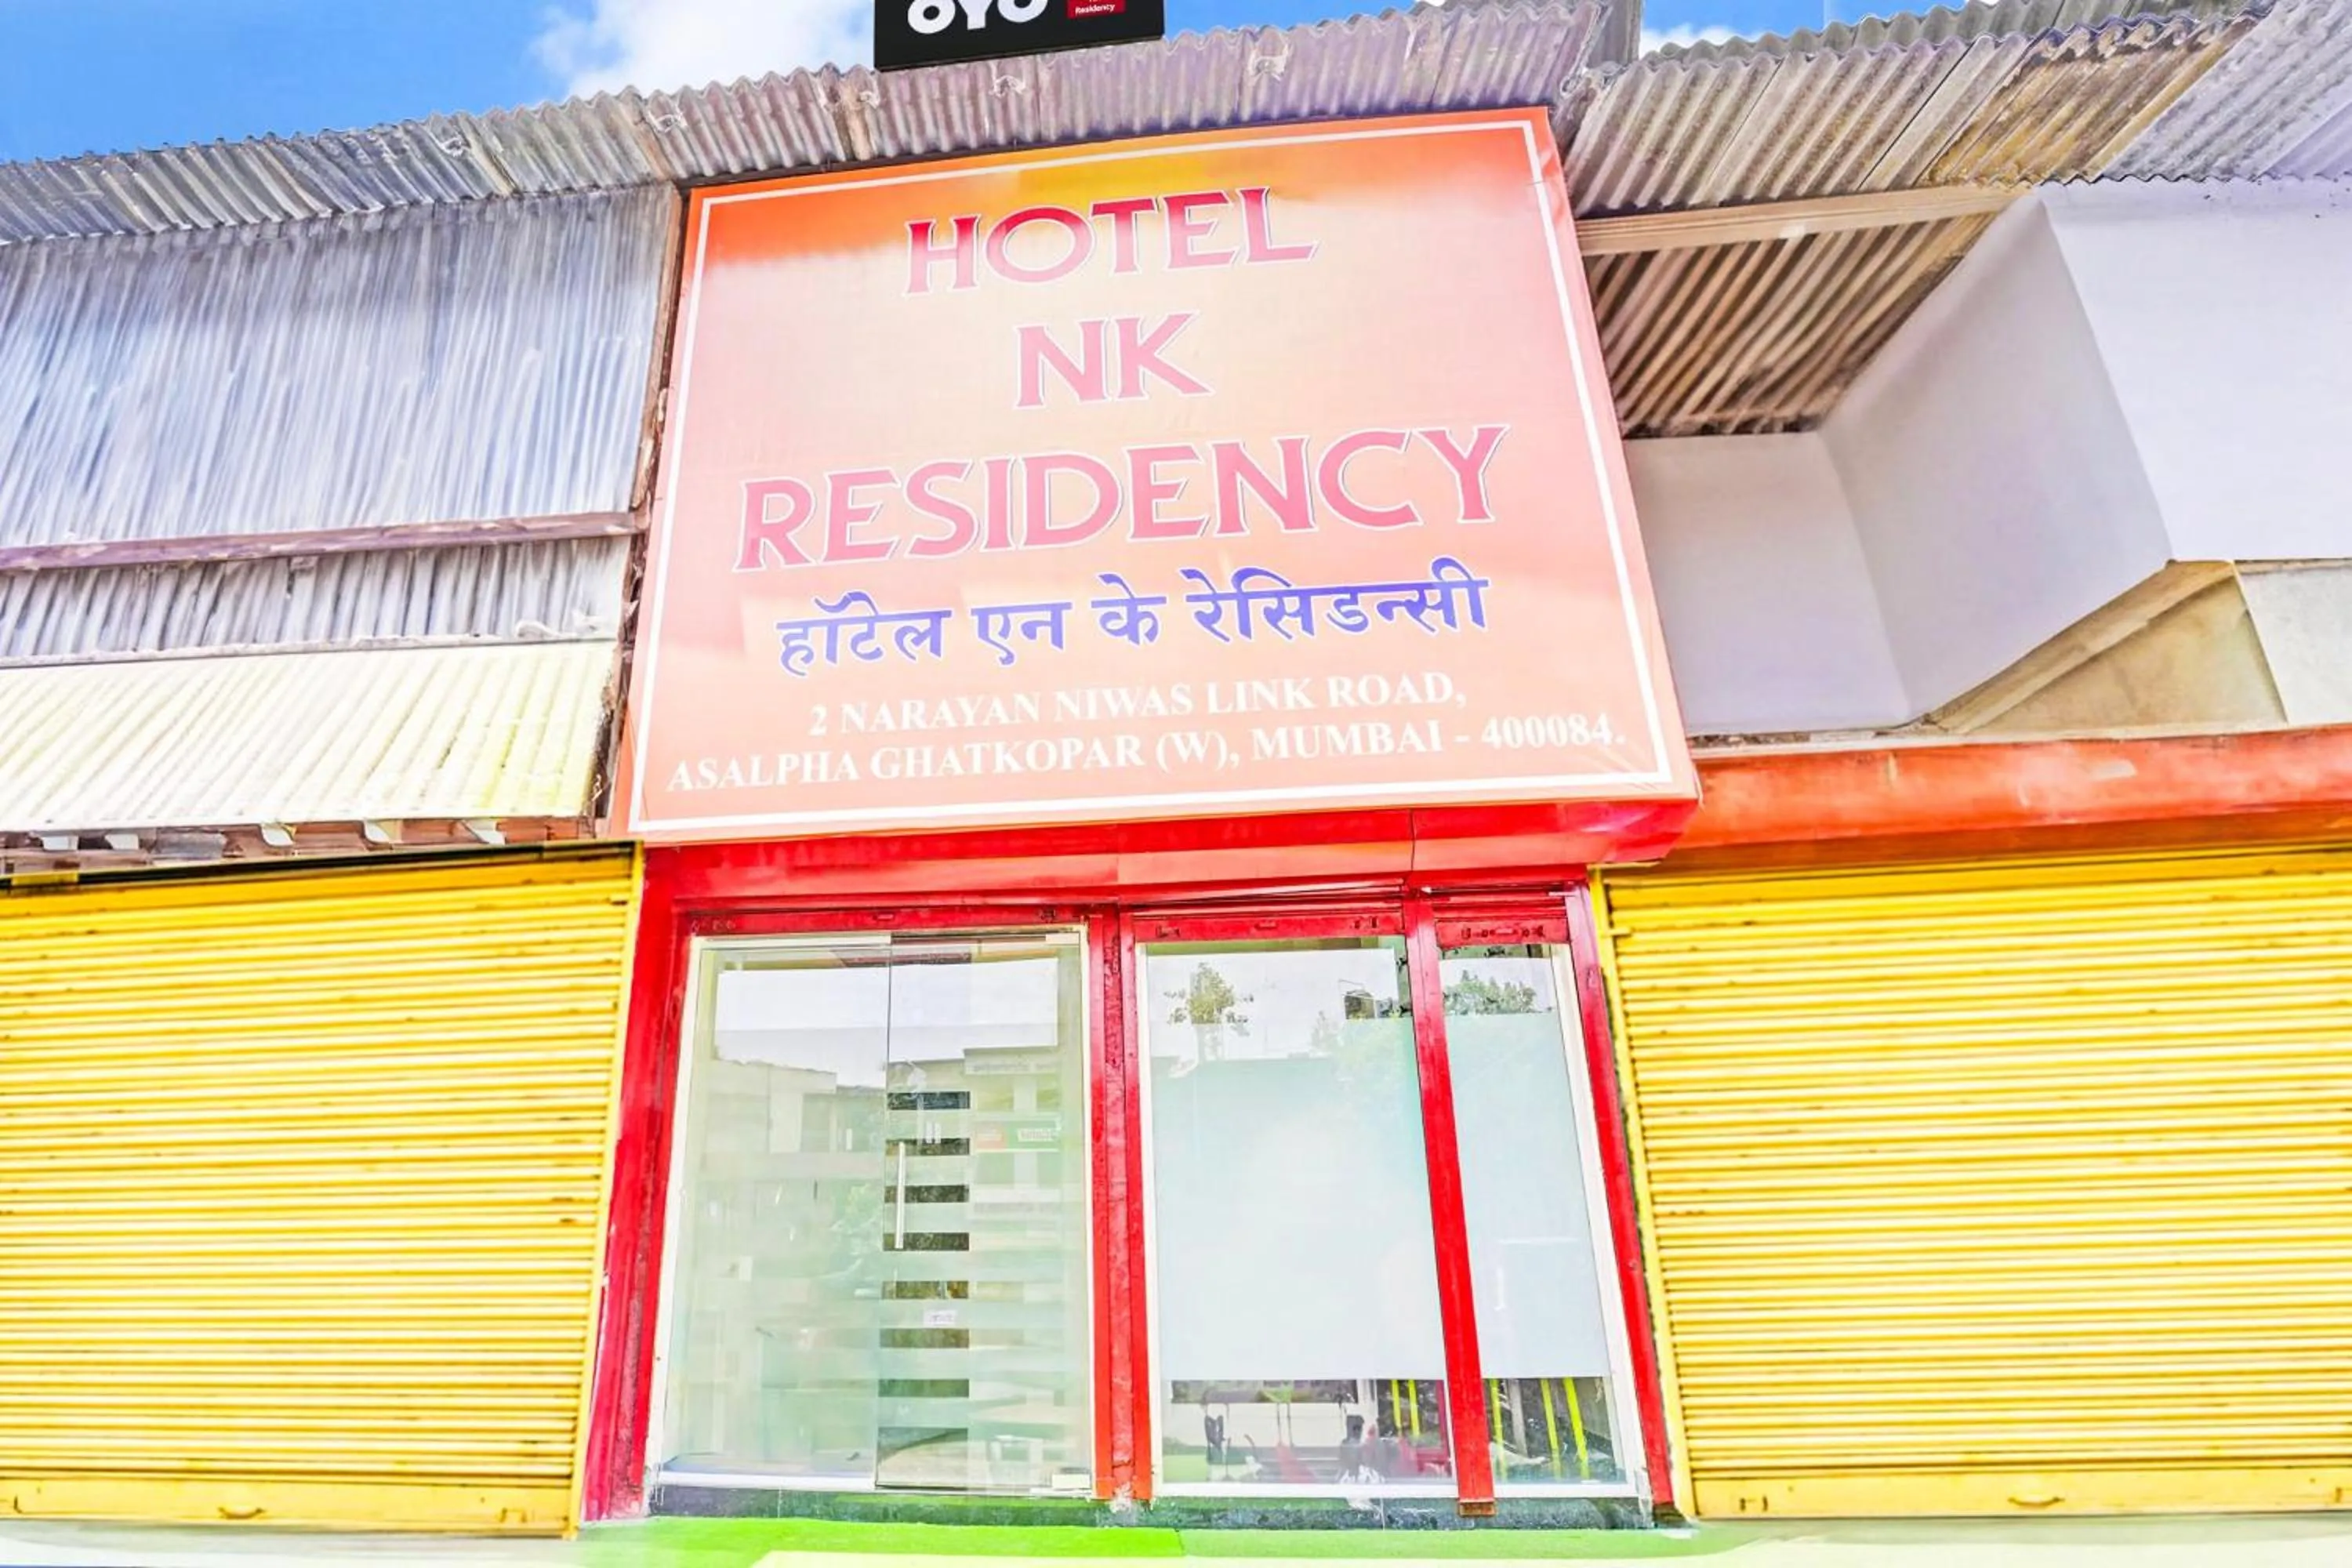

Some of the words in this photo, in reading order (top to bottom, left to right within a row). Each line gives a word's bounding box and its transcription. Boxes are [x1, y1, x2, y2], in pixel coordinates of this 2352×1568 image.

[904, 187, 1320, 293] HOTEL
[1013, 311, 1215, 408] NK
[731, 424, 1510, 570] RESIDENCY
[775, 590, 953, 677] हॉटेल
[971, 601, 1073, 666] एन
[1091, 572, 1167, 646] के
[1180, 556, 1490, 644] रेसिडन्सी
[666, 750, 862, 793] ASALPHA
[869, 734, 1145, 781] GHATKOPAR
[1156, 729, 1240, 773] (W),
[1251, 722, 1443, 762] MUMBAI
[1480, 712, 1627, 751] 400084.
[808, 705, 828, 736] 2
[840, 694, 1040, 734] NARAYAN
[1054, 681, 1194, 724] NIWAS
[1206, 676, 1316, 714] LINK
[1325, 671, 1467, 710] ROAD,
